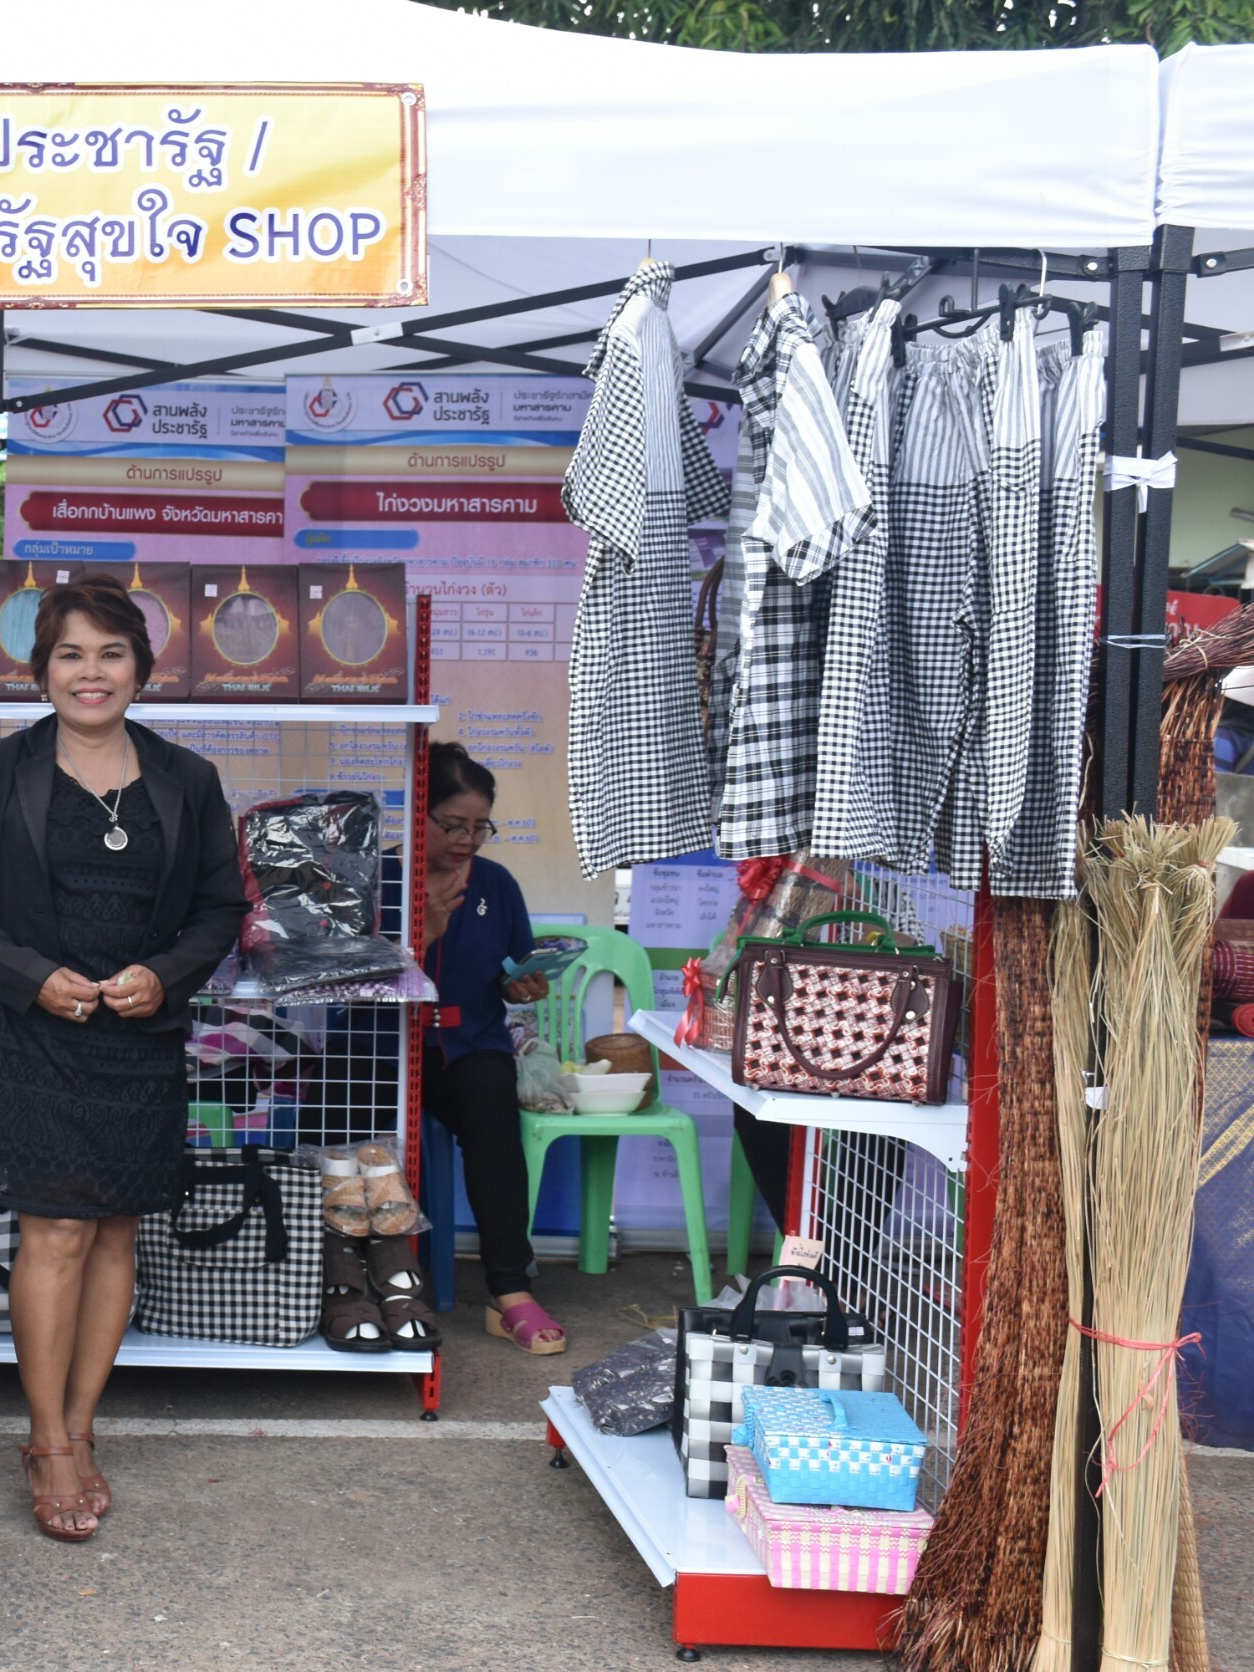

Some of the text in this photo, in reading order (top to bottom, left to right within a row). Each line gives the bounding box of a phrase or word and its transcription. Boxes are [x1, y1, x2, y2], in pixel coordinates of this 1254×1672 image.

[229, 212, 386, 259] SHOP
[433, 389, 490, 404] สานพลัง
[152, 401, 208, 418] สานพลัง
[433, 406, 490, 425] ประชารัฐ
[152, 419, 208, 439] ประชารัฐ
[407, 452, 506, 473] ด้านการแปรรูป
[126, 465, 223, 485] ด้านการแปรรูป
[52, 499, 156, 522] เสื่อกกบ้านแพง
[376, 491, 537, 514] ไก่งวงมหาสารคาม
